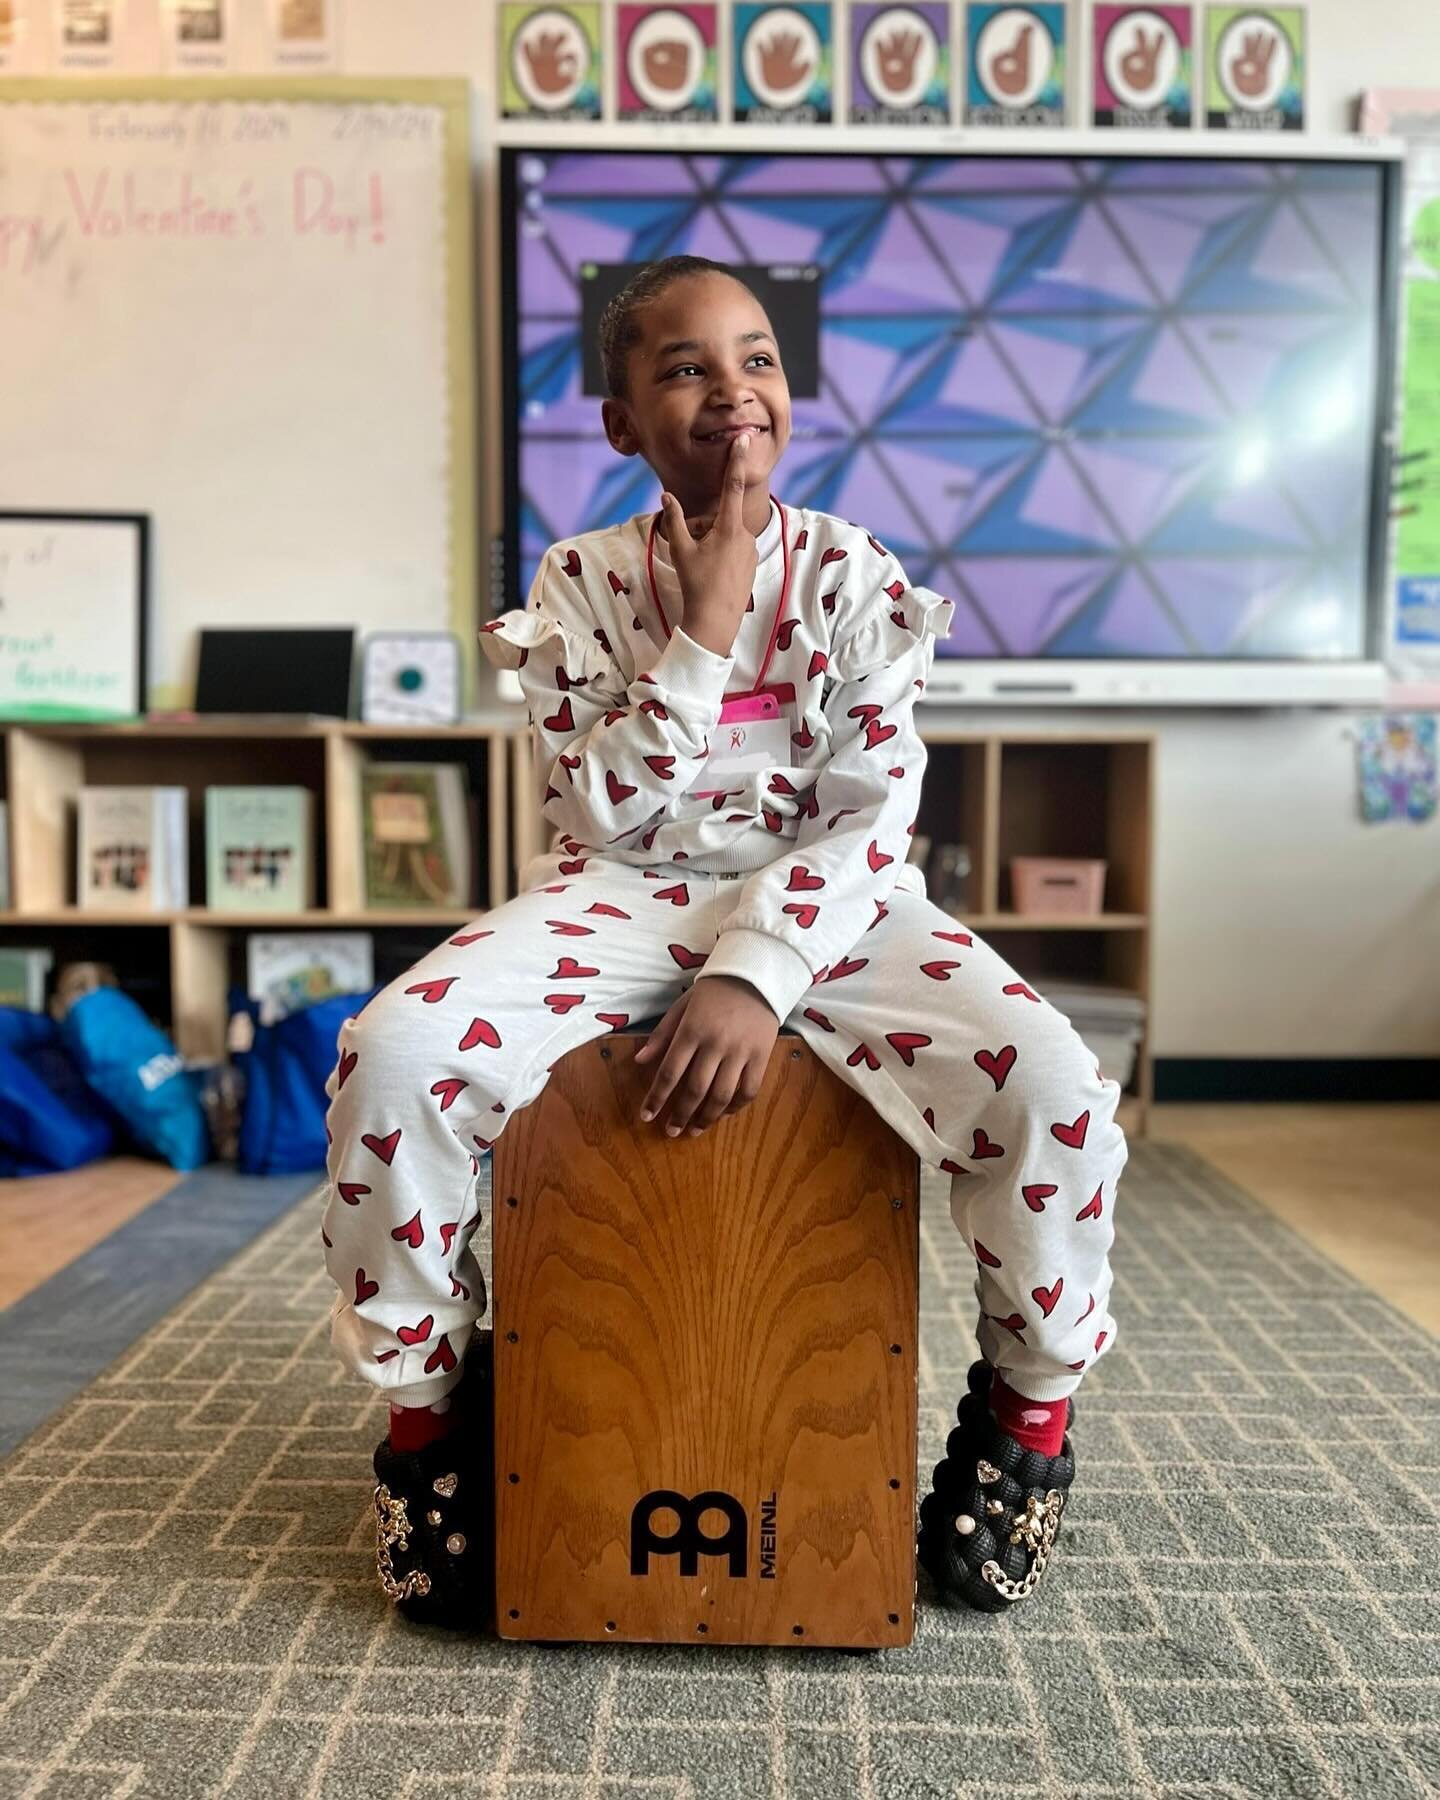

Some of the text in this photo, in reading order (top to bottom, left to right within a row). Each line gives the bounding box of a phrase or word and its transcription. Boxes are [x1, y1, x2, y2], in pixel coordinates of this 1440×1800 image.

[64, 166, 266, 238] Valentine's
[293, 166, 387, 253] Day!
[760, 1491, 777, 1579] MEINL
